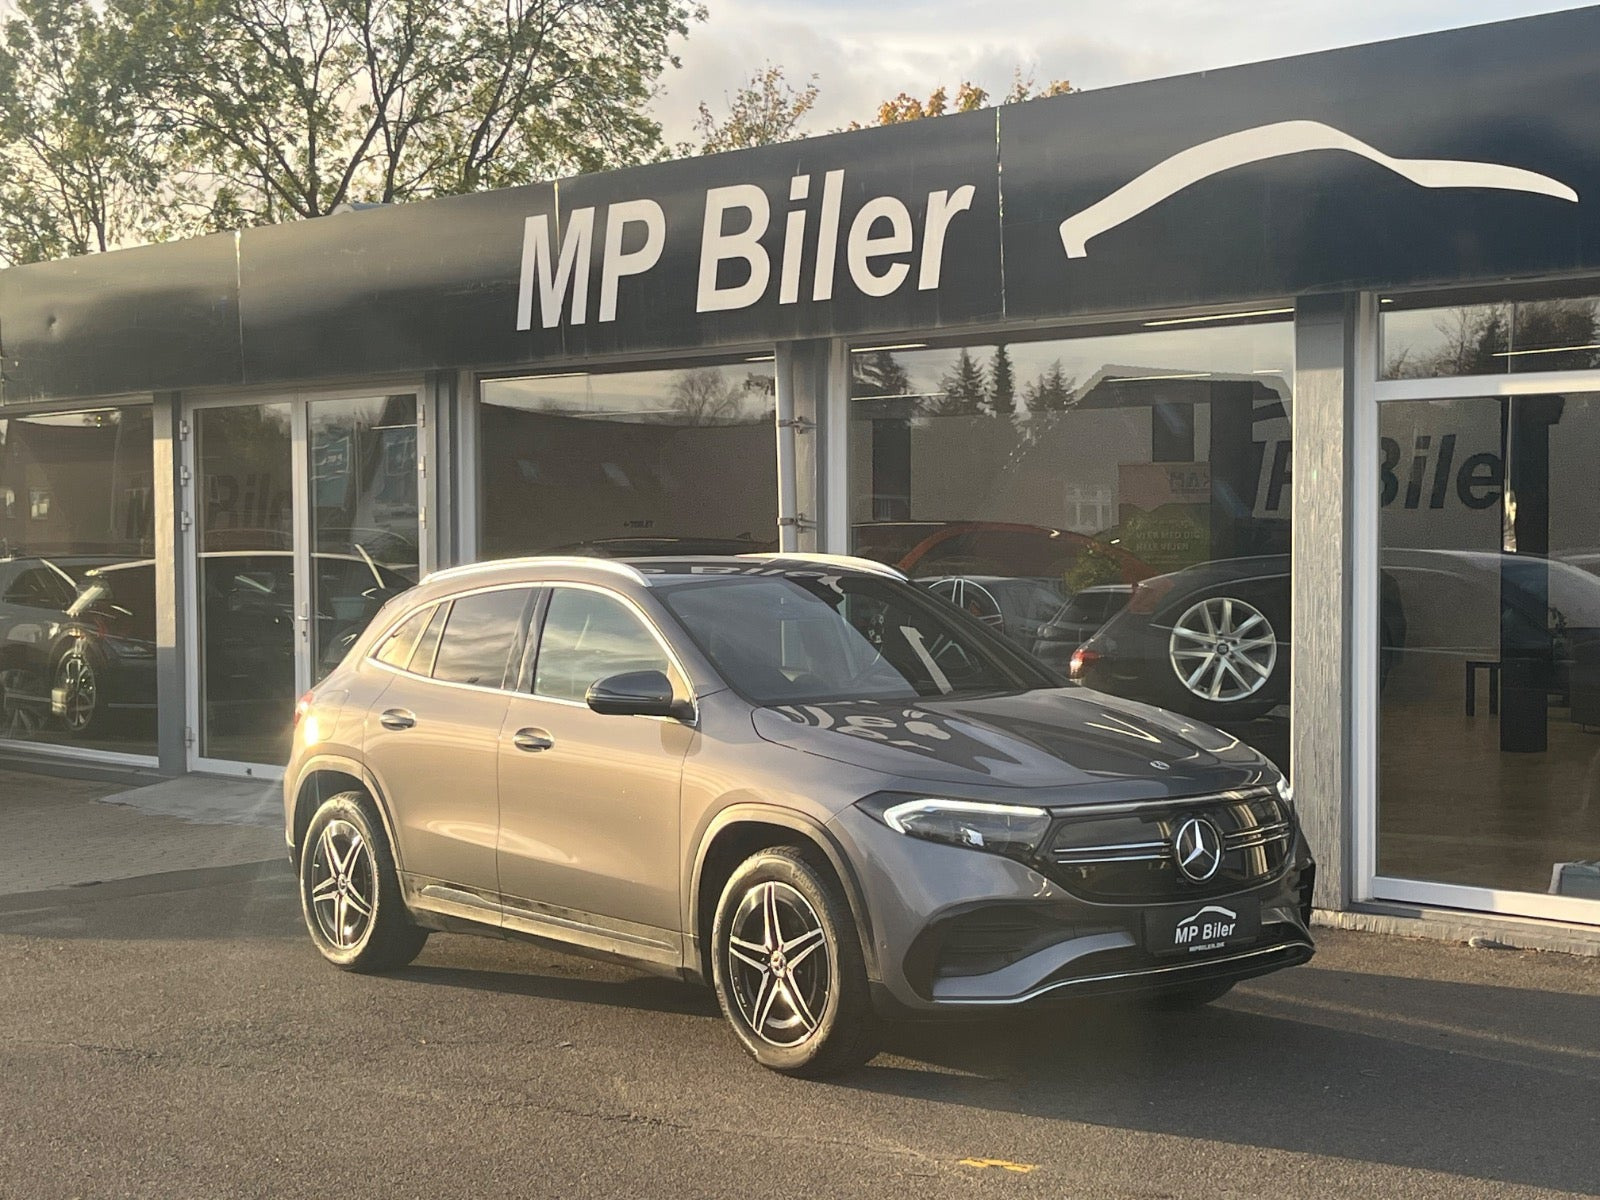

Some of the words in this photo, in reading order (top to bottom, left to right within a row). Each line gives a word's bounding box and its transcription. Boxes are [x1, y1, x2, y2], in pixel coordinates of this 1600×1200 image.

[516, 199, 666, 331] MP
[696, 169, 975, 312] Biler
[1381, 434, 1502, 510] ile
[1175, 926, 1198, 944] MP
[1202, 922, 1235, 940] Biler
